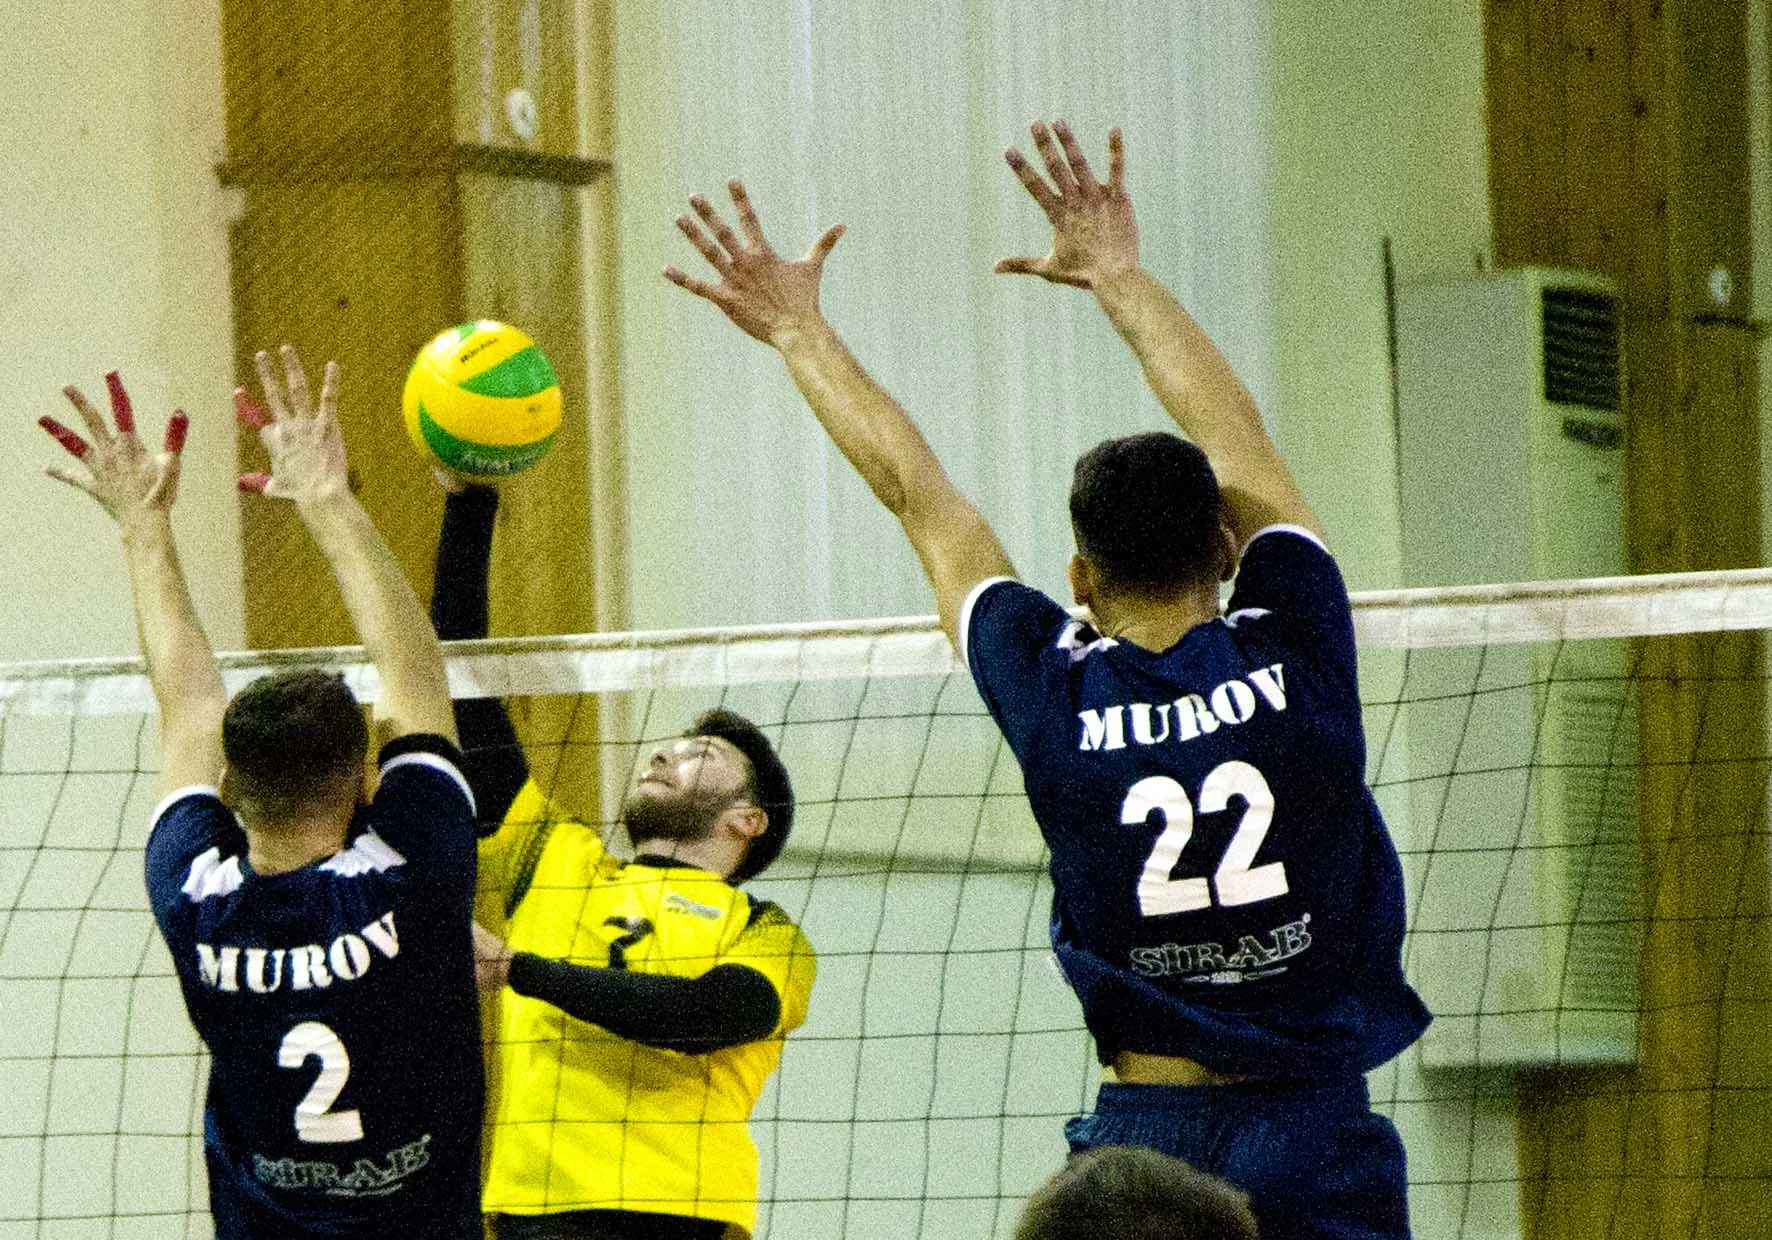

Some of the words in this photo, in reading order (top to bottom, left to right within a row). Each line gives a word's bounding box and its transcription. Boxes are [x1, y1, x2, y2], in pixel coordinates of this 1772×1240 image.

[1079, 664, 1286, 750] MUROV
[1121, 761, 1288, 916] 22
[197, 912, 398, 992] MUROV
[279, 1023, 362, 1142] 2
